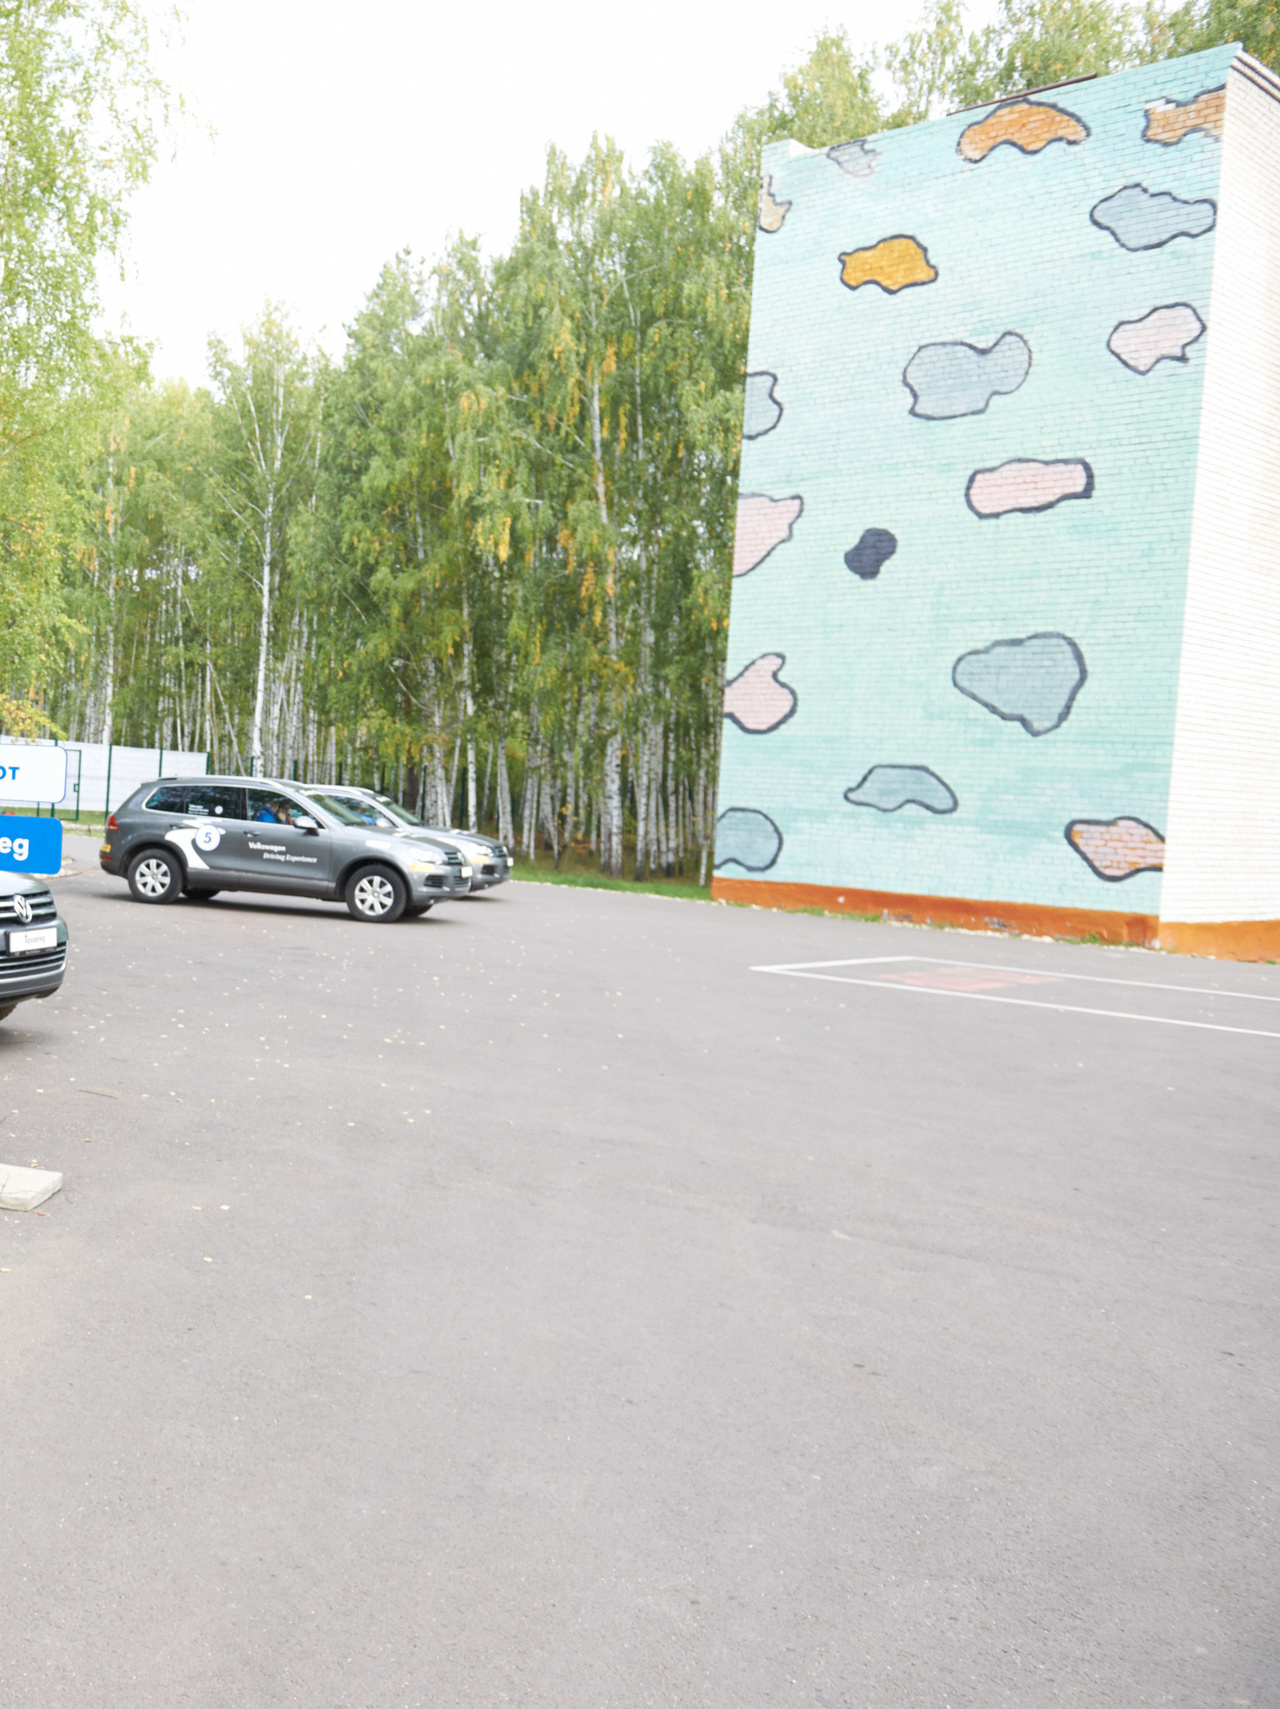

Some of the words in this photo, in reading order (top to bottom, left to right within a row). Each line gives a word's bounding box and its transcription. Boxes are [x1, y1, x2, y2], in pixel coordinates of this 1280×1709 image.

[203, 831, 212, 843] 5
[248, 841, 286, 853] Volkswagen
[263, 852, 286, 862] Driving
[286, 853, 318, 863] Experience
